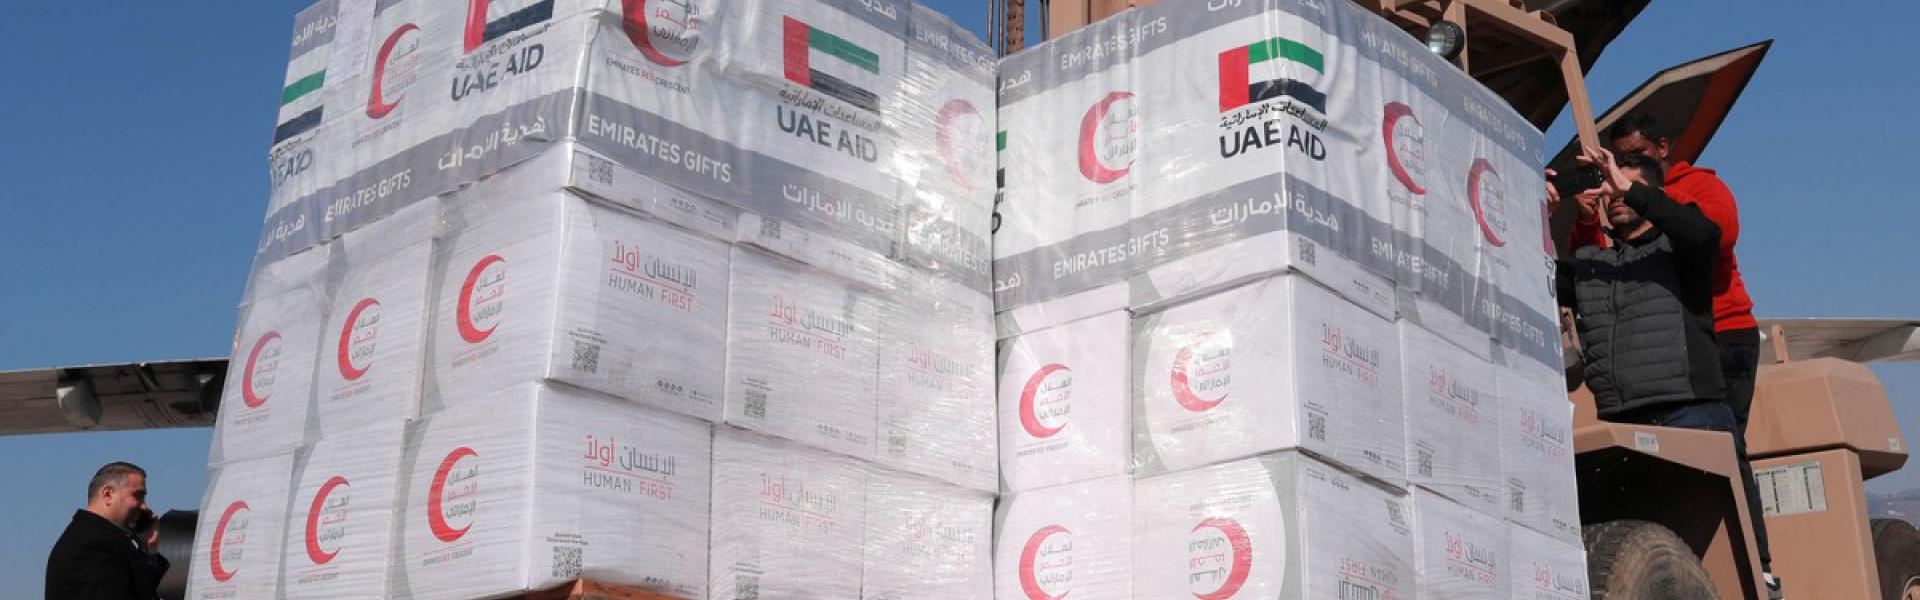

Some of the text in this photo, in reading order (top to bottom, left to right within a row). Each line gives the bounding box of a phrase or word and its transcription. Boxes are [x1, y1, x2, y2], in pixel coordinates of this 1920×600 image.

[505, 43, 545, 76] AID
[588, 115, 731, 182] EMIRATES GIFTS
[776, 104, 878, 164] UAE AID
[1218, 118, 1327, 161] UAE AID
[378, 168, 411, 199] GIFTS
[782, 183, 850, 224] الإمارات
[1295, 193, 1339, 233] هدية
[1053, 228, 1169, 280] EMIRATES GIFTS
[608, 272, 694, 313] HUMAN FIRST
[769, 325, 811, 350] HUMAN
[583, 471, 674, 500] HUMAN FIRST
[759, 505, 800, 528] HUMAN
